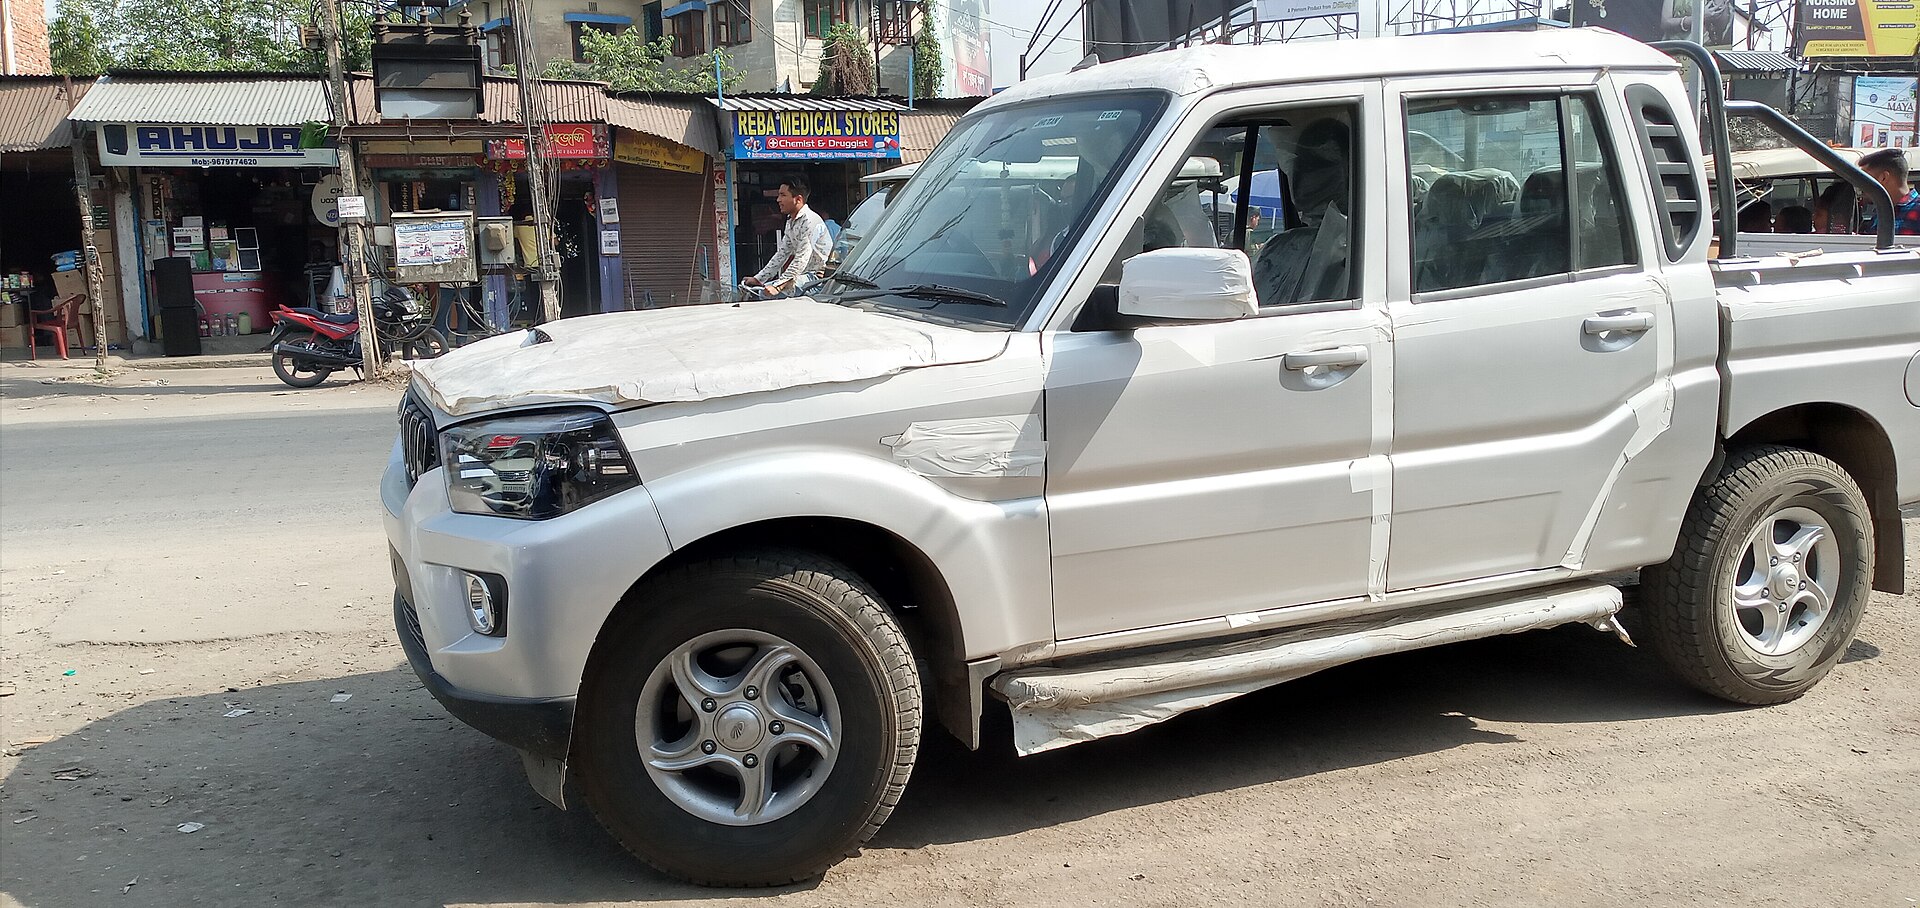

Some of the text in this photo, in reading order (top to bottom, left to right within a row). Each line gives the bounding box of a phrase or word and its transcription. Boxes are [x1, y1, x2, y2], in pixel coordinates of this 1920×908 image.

[1813, 9, 1848, 19] HOME
[1888, 102, 1914, 112] MAYA
[738, 111, 897, 136] REBA MEDICAL STORES
[137, 127, 301, 150] AHUJA
[779, 139, 868, 149] Chemist & Druggist
